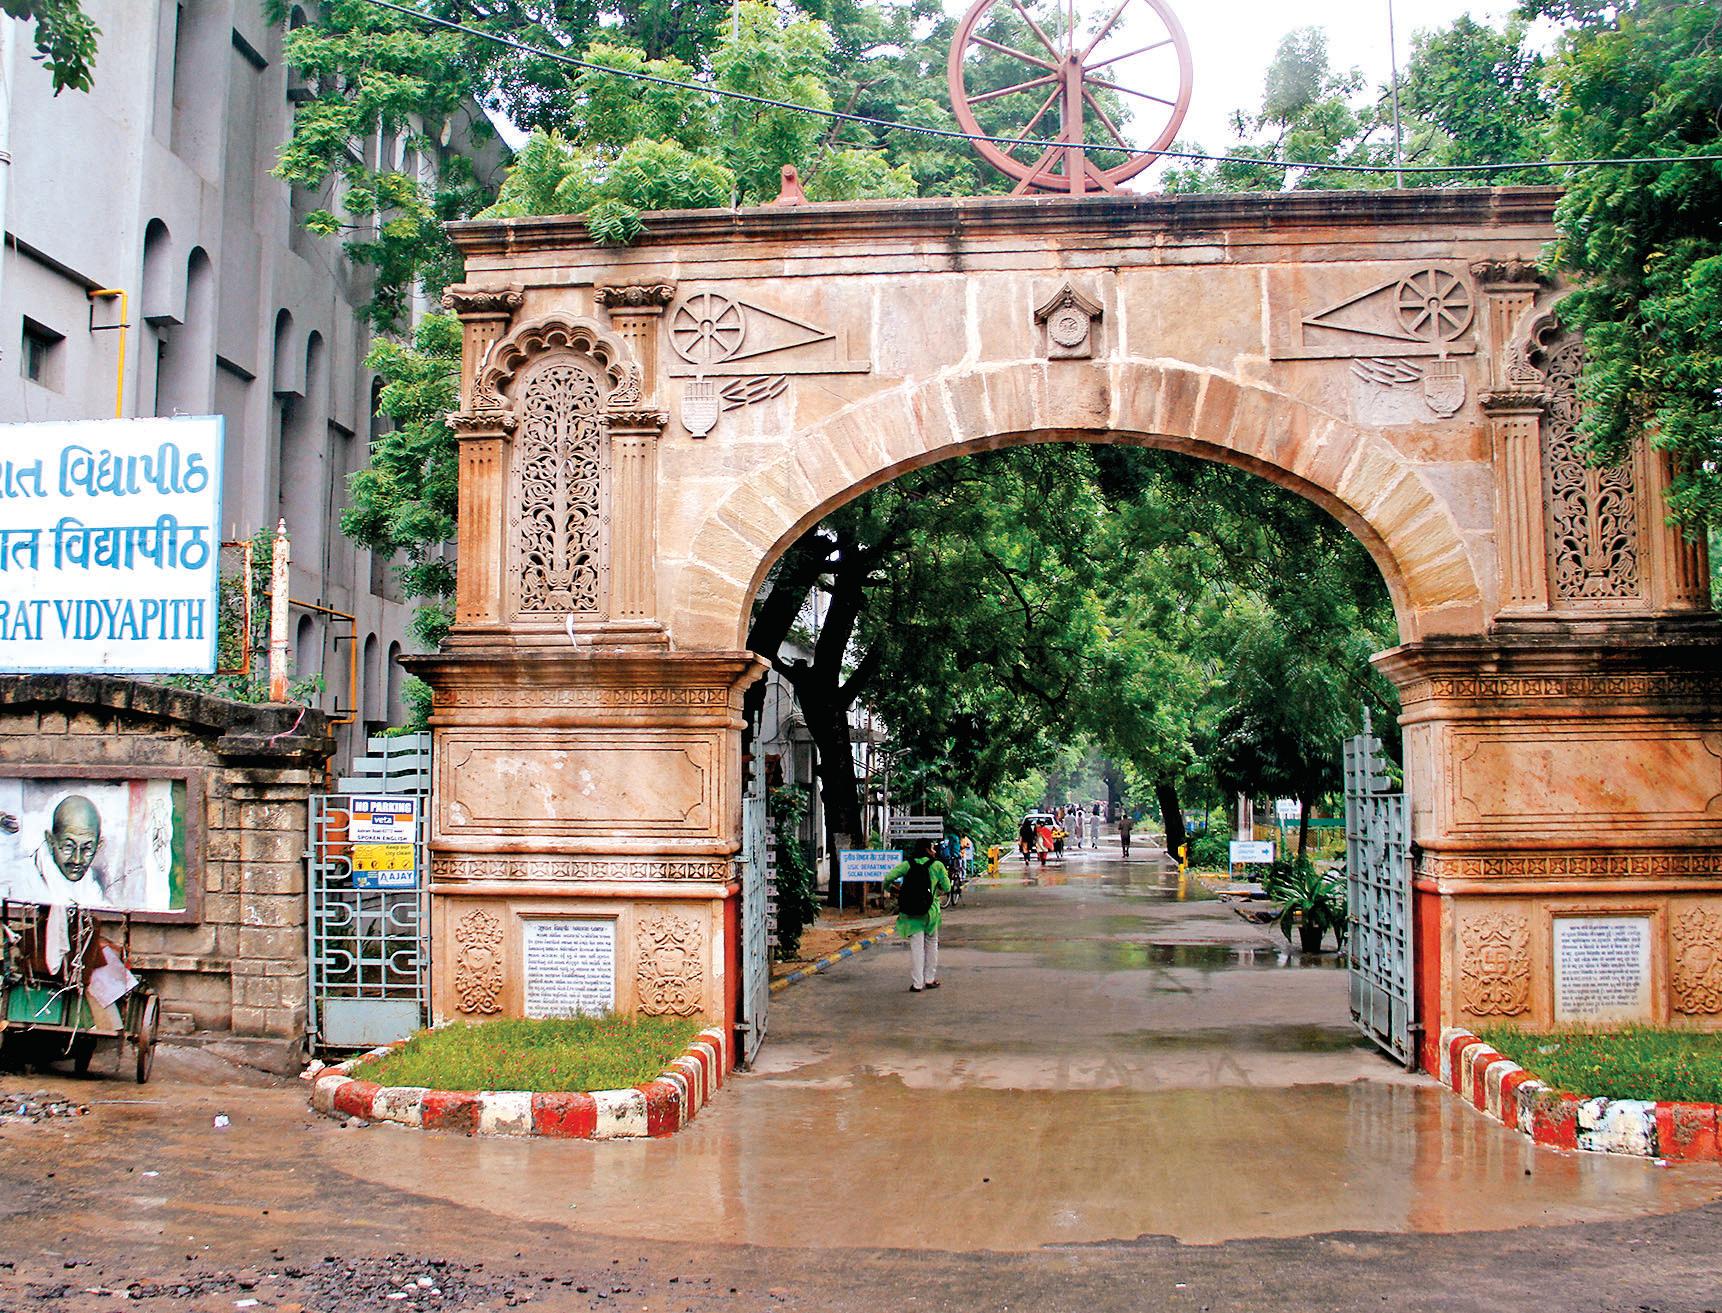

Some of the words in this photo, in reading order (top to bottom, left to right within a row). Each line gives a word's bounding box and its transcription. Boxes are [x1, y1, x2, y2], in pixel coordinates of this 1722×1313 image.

[58, 442, 209, 497] વિદ્યાપીઠ
[49, 513, 210, 571] विद्यापीठ
[51, 598, 206, 641] VIDYAPITH
[355, 801, 369, 812] NO
[370, 802, 412, 813] PARKING
